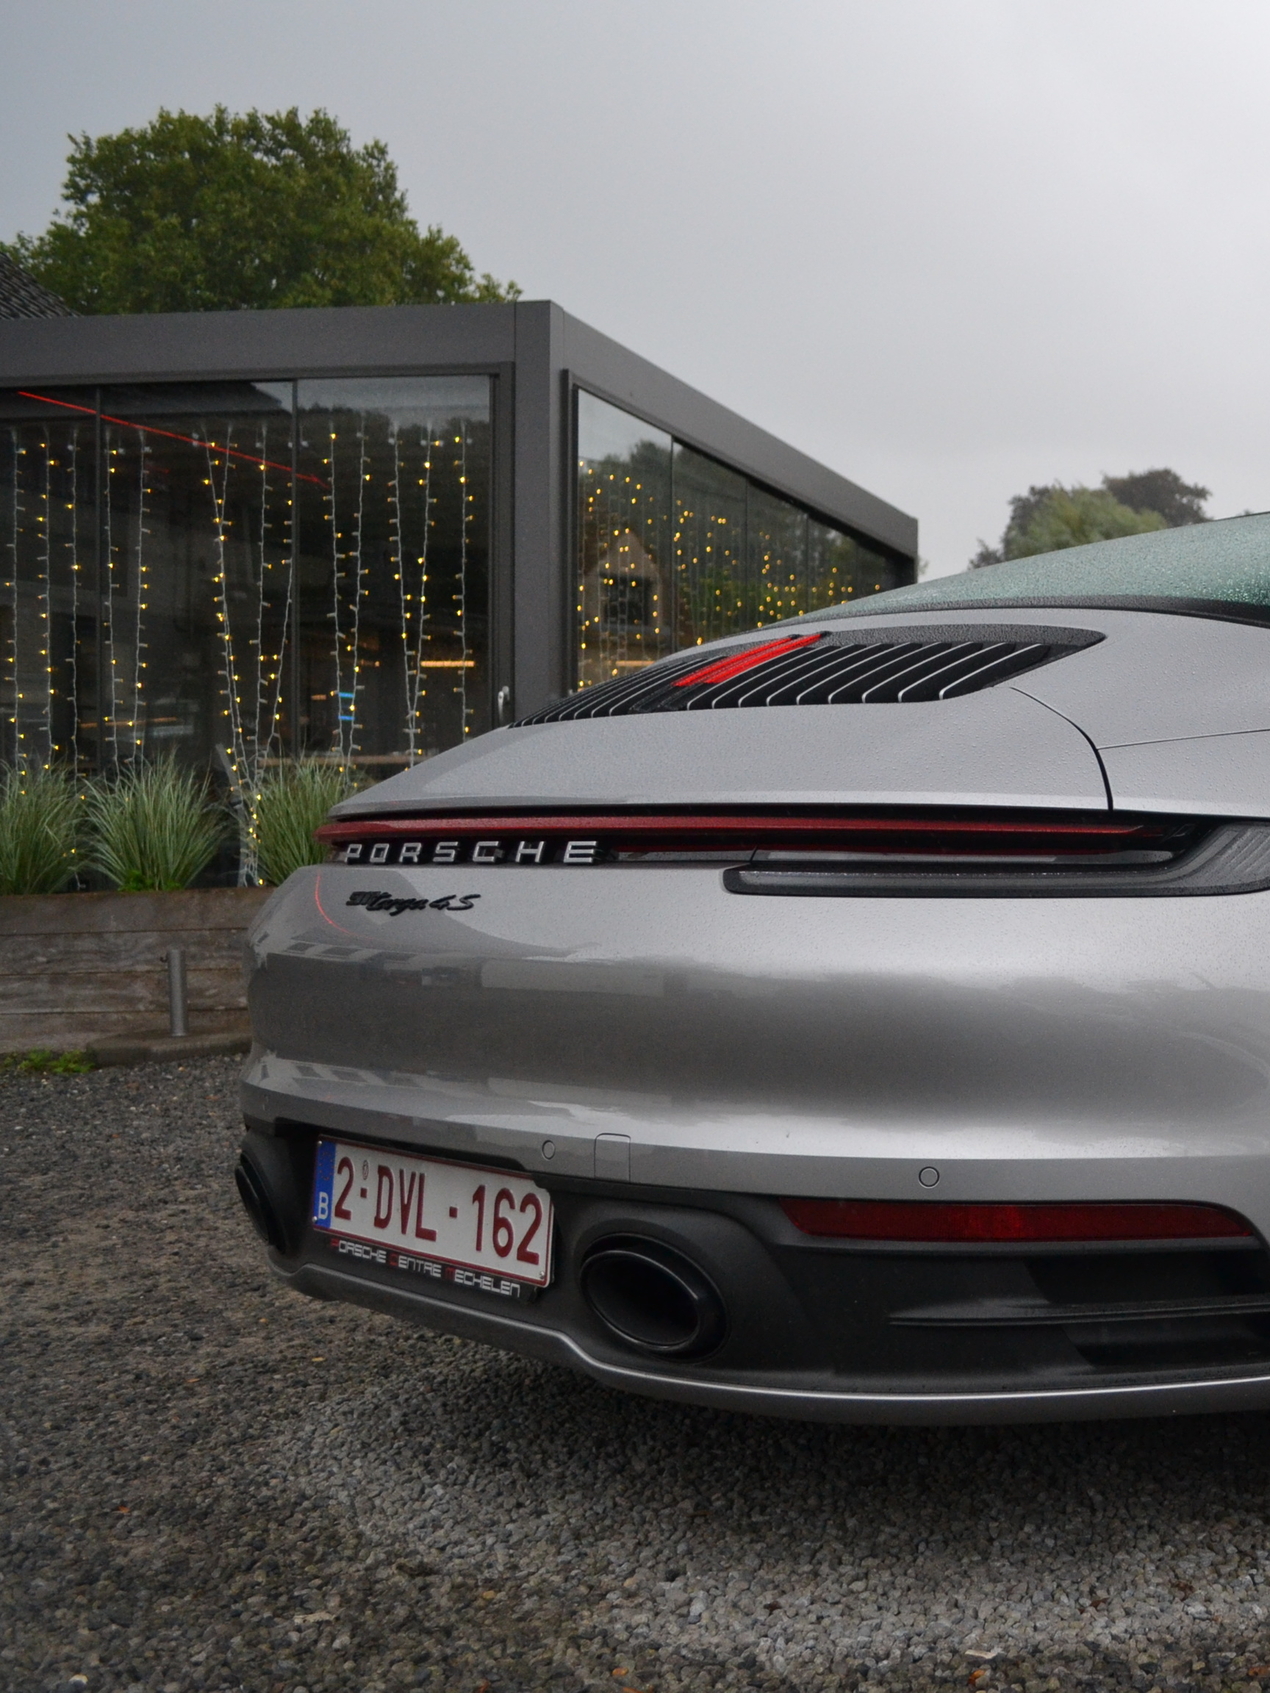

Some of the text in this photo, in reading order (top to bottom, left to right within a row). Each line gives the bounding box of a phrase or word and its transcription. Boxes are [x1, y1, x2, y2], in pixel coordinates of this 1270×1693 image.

[344, 840, 598, 865] PORSCHE
[317, 1191, 330, 1220] B
[330, 1238, 520, 1298] PORSCHE CENTRE MECHELEN
